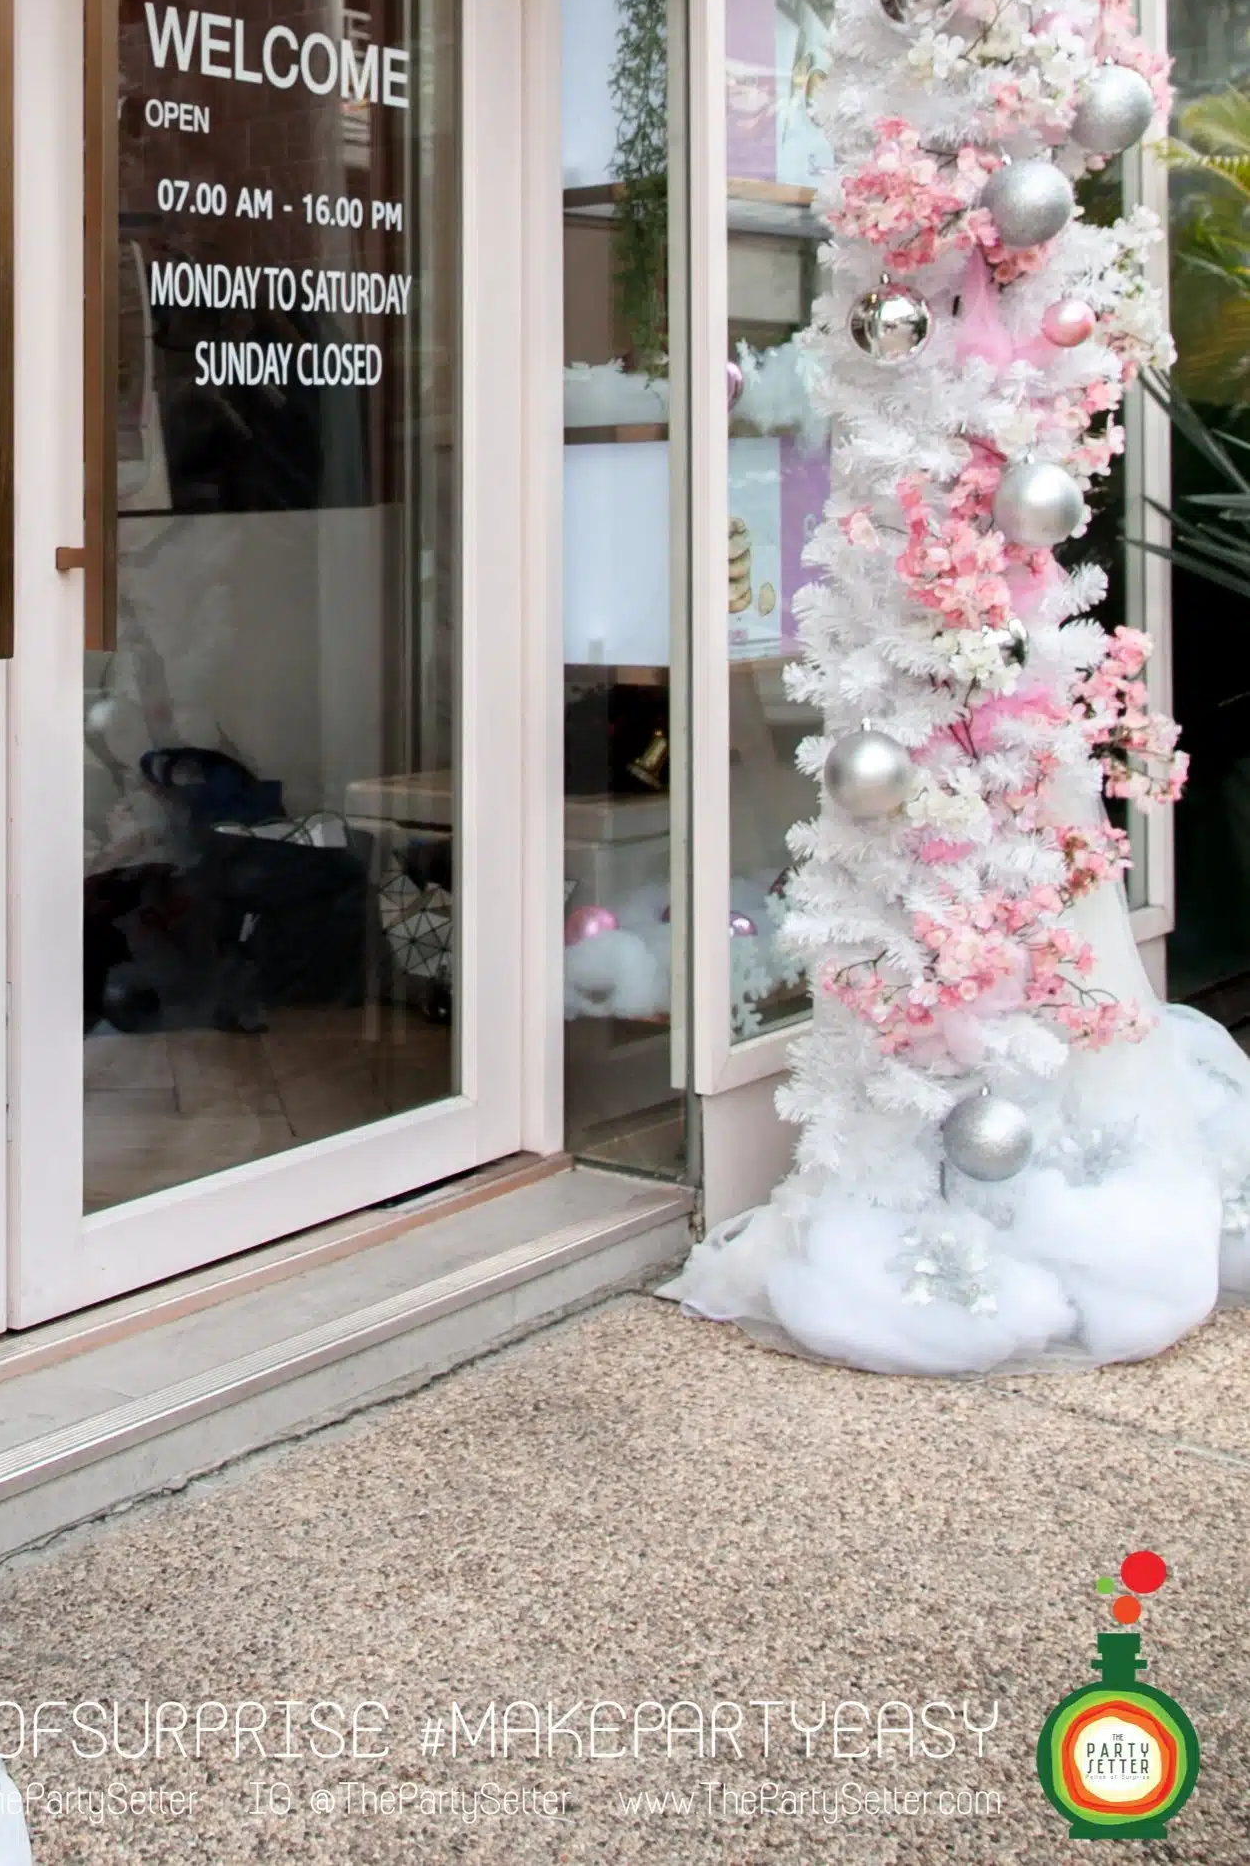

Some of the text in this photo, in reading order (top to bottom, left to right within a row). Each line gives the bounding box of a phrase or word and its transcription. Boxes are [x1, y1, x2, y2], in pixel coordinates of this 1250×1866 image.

[144, 2, 410, 108] WELCOME
[145, 99, 210, 133] OPEN
[157, 179, 227, 216] 07.00
[236, 188, 273, 220] AM
[302, 194, 363, 229] 16.00
[371, 201, 403, 232] PM
[151, 261, 412, 315] MONDAY TO SATURDAY
[194, 340, 382, 385] SUNDAY CLOSED
